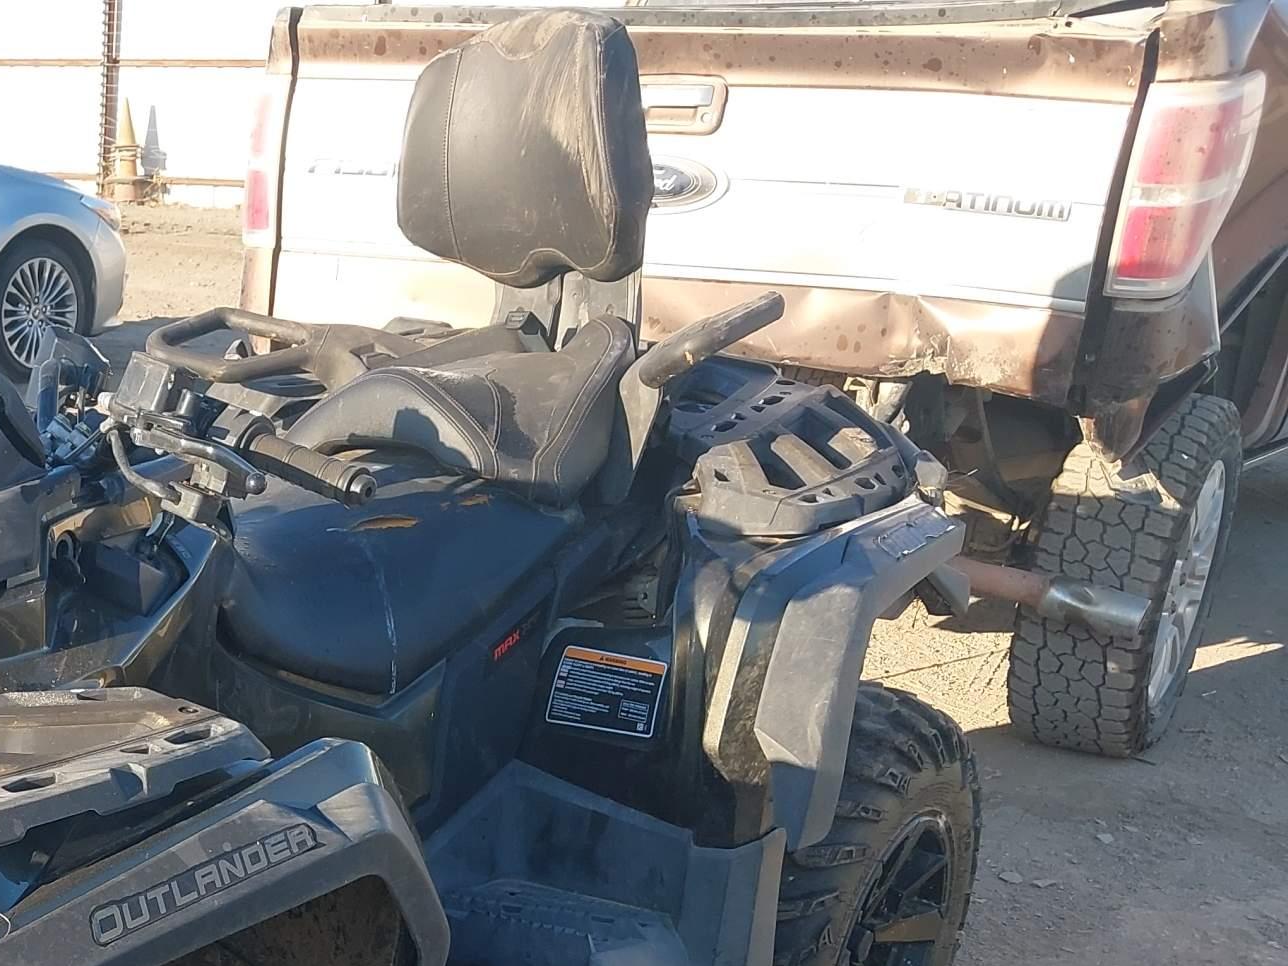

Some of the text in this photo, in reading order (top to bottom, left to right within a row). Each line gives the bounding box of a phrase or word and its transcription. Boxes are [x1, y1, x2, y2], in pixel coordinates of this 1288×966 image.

[904, 188, 1065, 220] ATINUM
[494, 629, 520, 661] MAX
[92, 823, 316, 943] OUTLANDER
